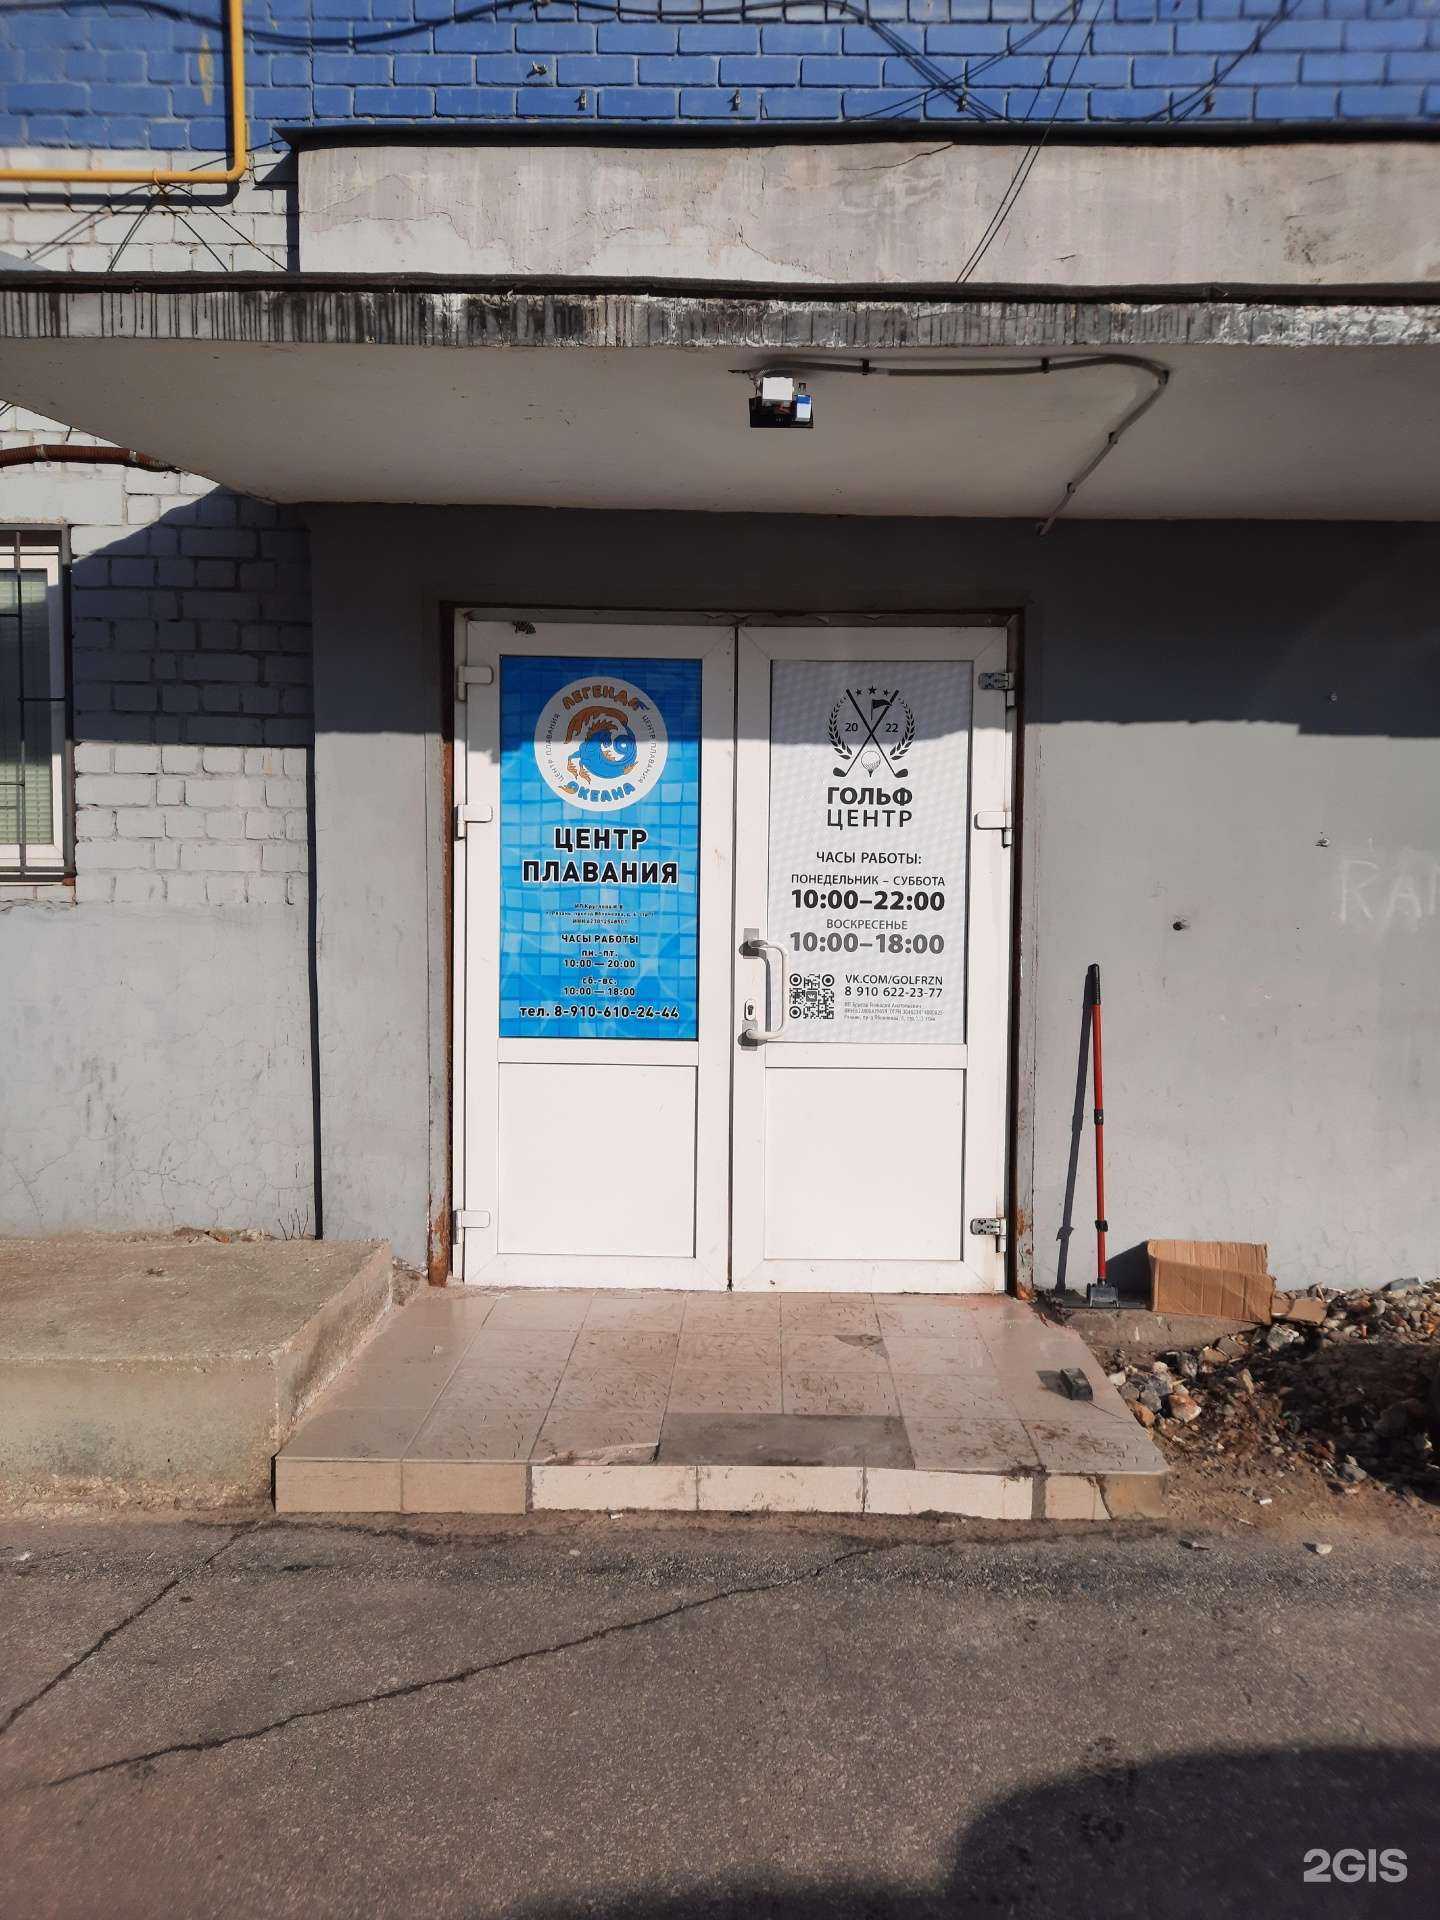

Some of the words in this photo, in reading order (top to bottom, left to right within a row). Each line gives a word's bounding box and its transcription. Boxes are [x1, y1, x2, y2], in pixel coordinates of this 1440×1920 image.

[562, 685, 640, 711] ЛЕГЕНДА
[845, 722, 858, 732] 20
[886, 723, 898, 733] 22
[566, 780, 636, 802] ОКЕАНА
[827, 786, 913, 806] ГОЛЬФ
[827, 809, 912, 830] ЦЕНТР
[554, 827, 648, 852] ЦЕНТР
[816, 852, 856, 864] ЧАСЫ
[861, 853, 922, 865] РАБОТЫ:
[522, 860, 678, 884] ПЛАВАНИЯ
[791, 874, 879, 886] ПОНЕДЕЛЬНИК
[893, 876, 946, 886] СУББОТА
[826, 919, 908, 930] ВОСКРЕСЕНЬЕ
[561, 934, 591, 943] ЧАСЫ
[594, 935, 639, 944] РАБОТЫ
[564, 959, 592, 968] 10:00
[607, 960, 636, 968] 20:00
[845, 974, 943, 985] VK.COM/GOLFRZN
[564, 987, 592, 995] 10:00
[608, 988, 636, 996] 18:00
[844, 987, 852, 996] 8
[856, 987, 878, 997] 910
[883, 988, 943, 998] 622-23-77
[519, 1006, 550, 1017] тел.
[554, 1006, 679, 1018] 8-910-610-24-44
